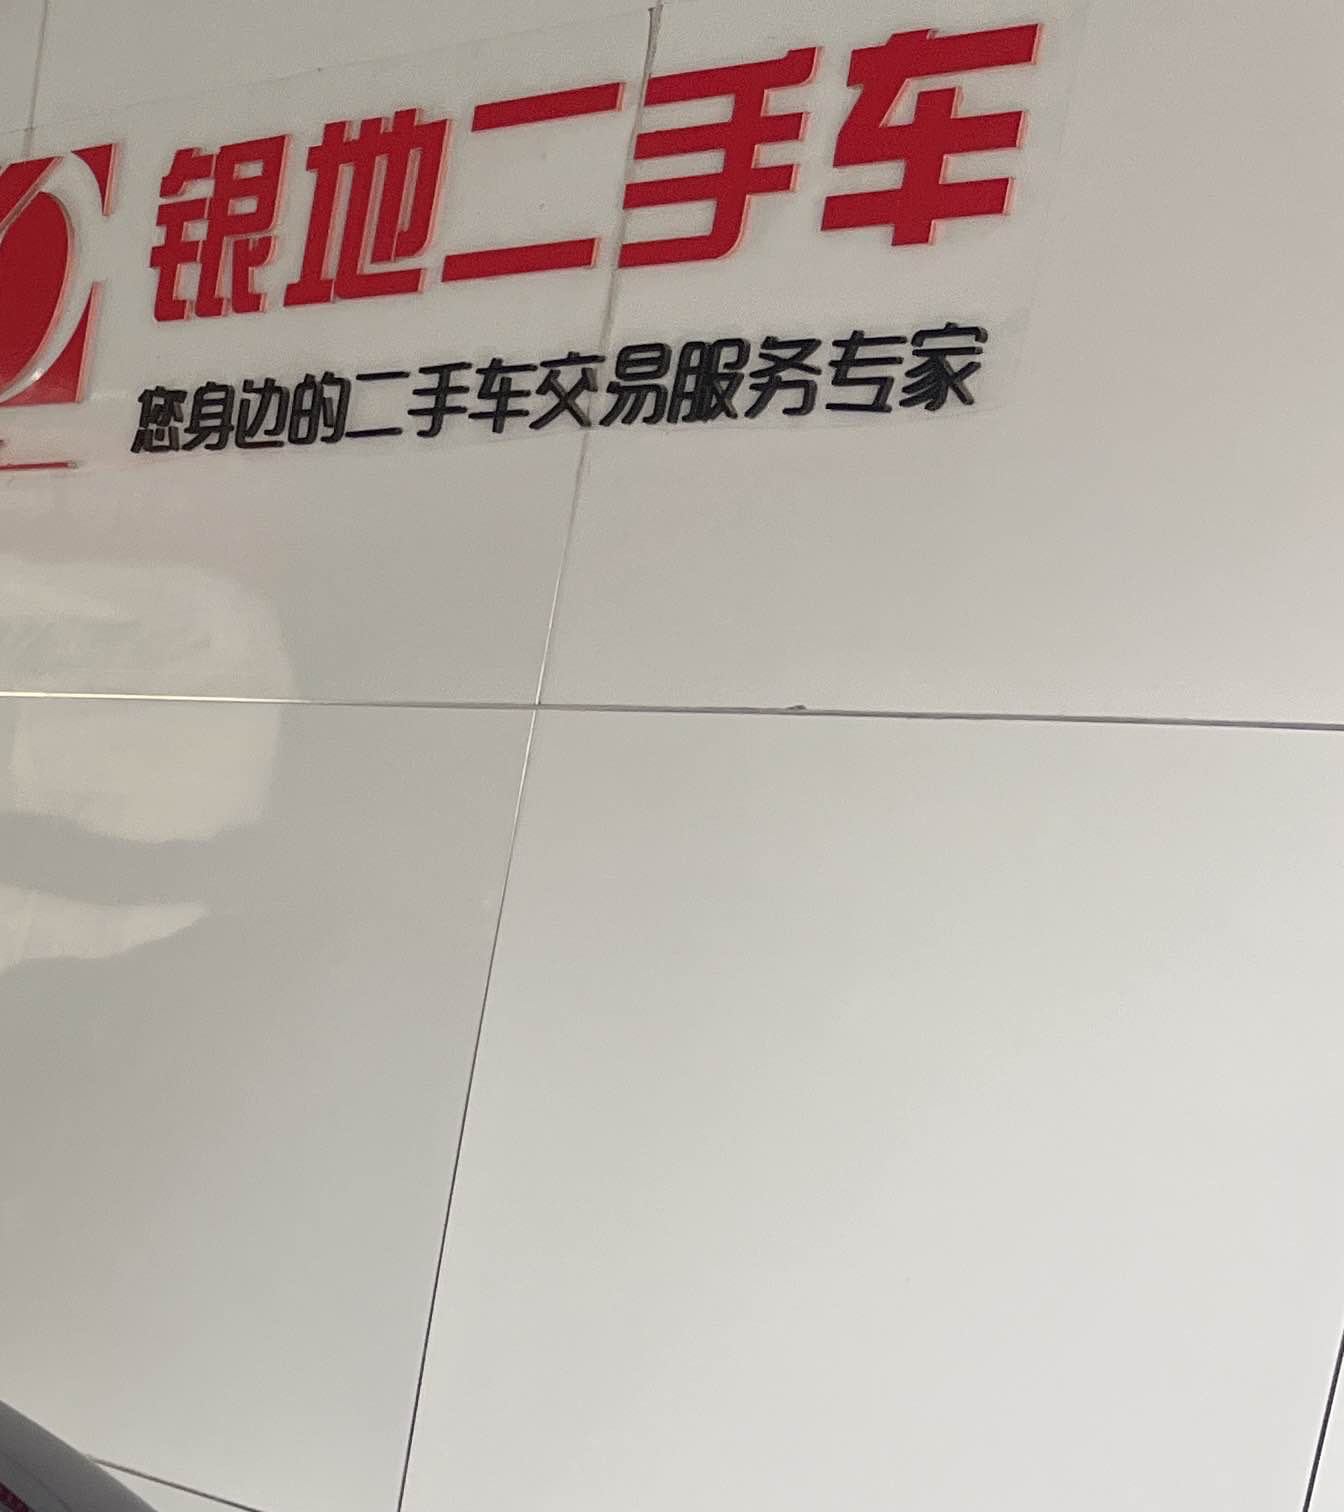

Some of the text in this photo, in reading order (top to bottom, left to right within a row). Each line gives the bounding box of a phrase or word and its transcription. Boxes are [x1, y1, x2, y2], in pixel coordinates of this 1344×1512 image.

[150, 23, 1042, 322] 银地二手车
[130, 321, 988, 454] 您身边的二手车交易服务专家
